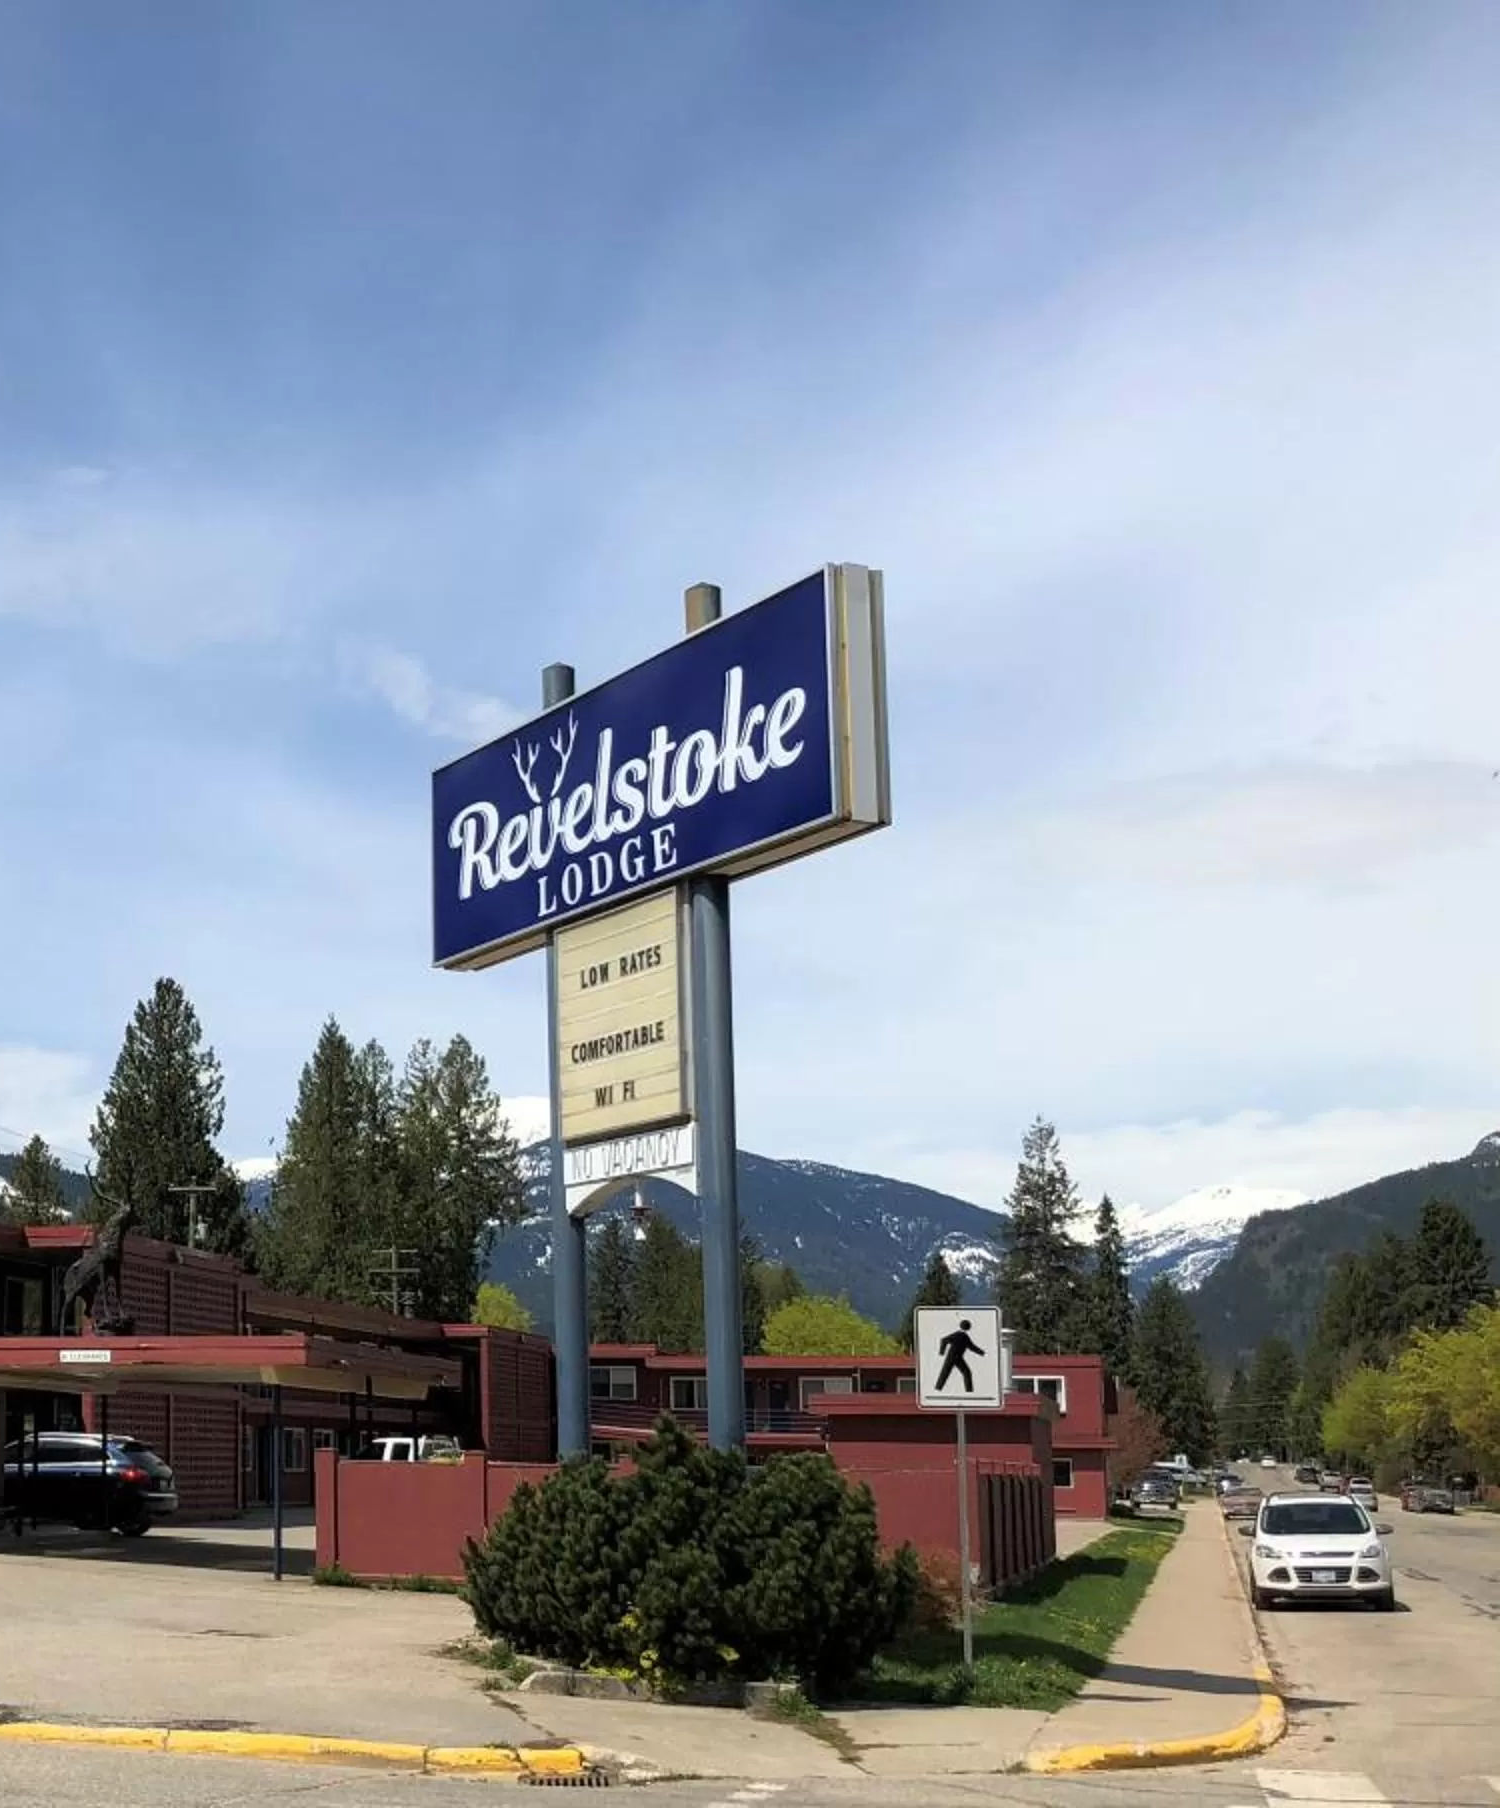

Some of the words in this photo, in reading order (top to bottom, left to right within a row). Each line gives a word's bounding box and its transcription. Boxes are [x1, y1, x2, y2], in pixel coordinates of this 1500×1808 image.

[448, 665, 807, 900] Revelstoke
[537, 823, 678, 917] LODGE
[580, 962, 609, 989] LOW
[619, 944, 661, 977] RATES
[571, 1020, 665, 1064] COMFORTABLE
[595, 1085, 613, 1107] WI
[623, 1080, 635, 1101] FI
